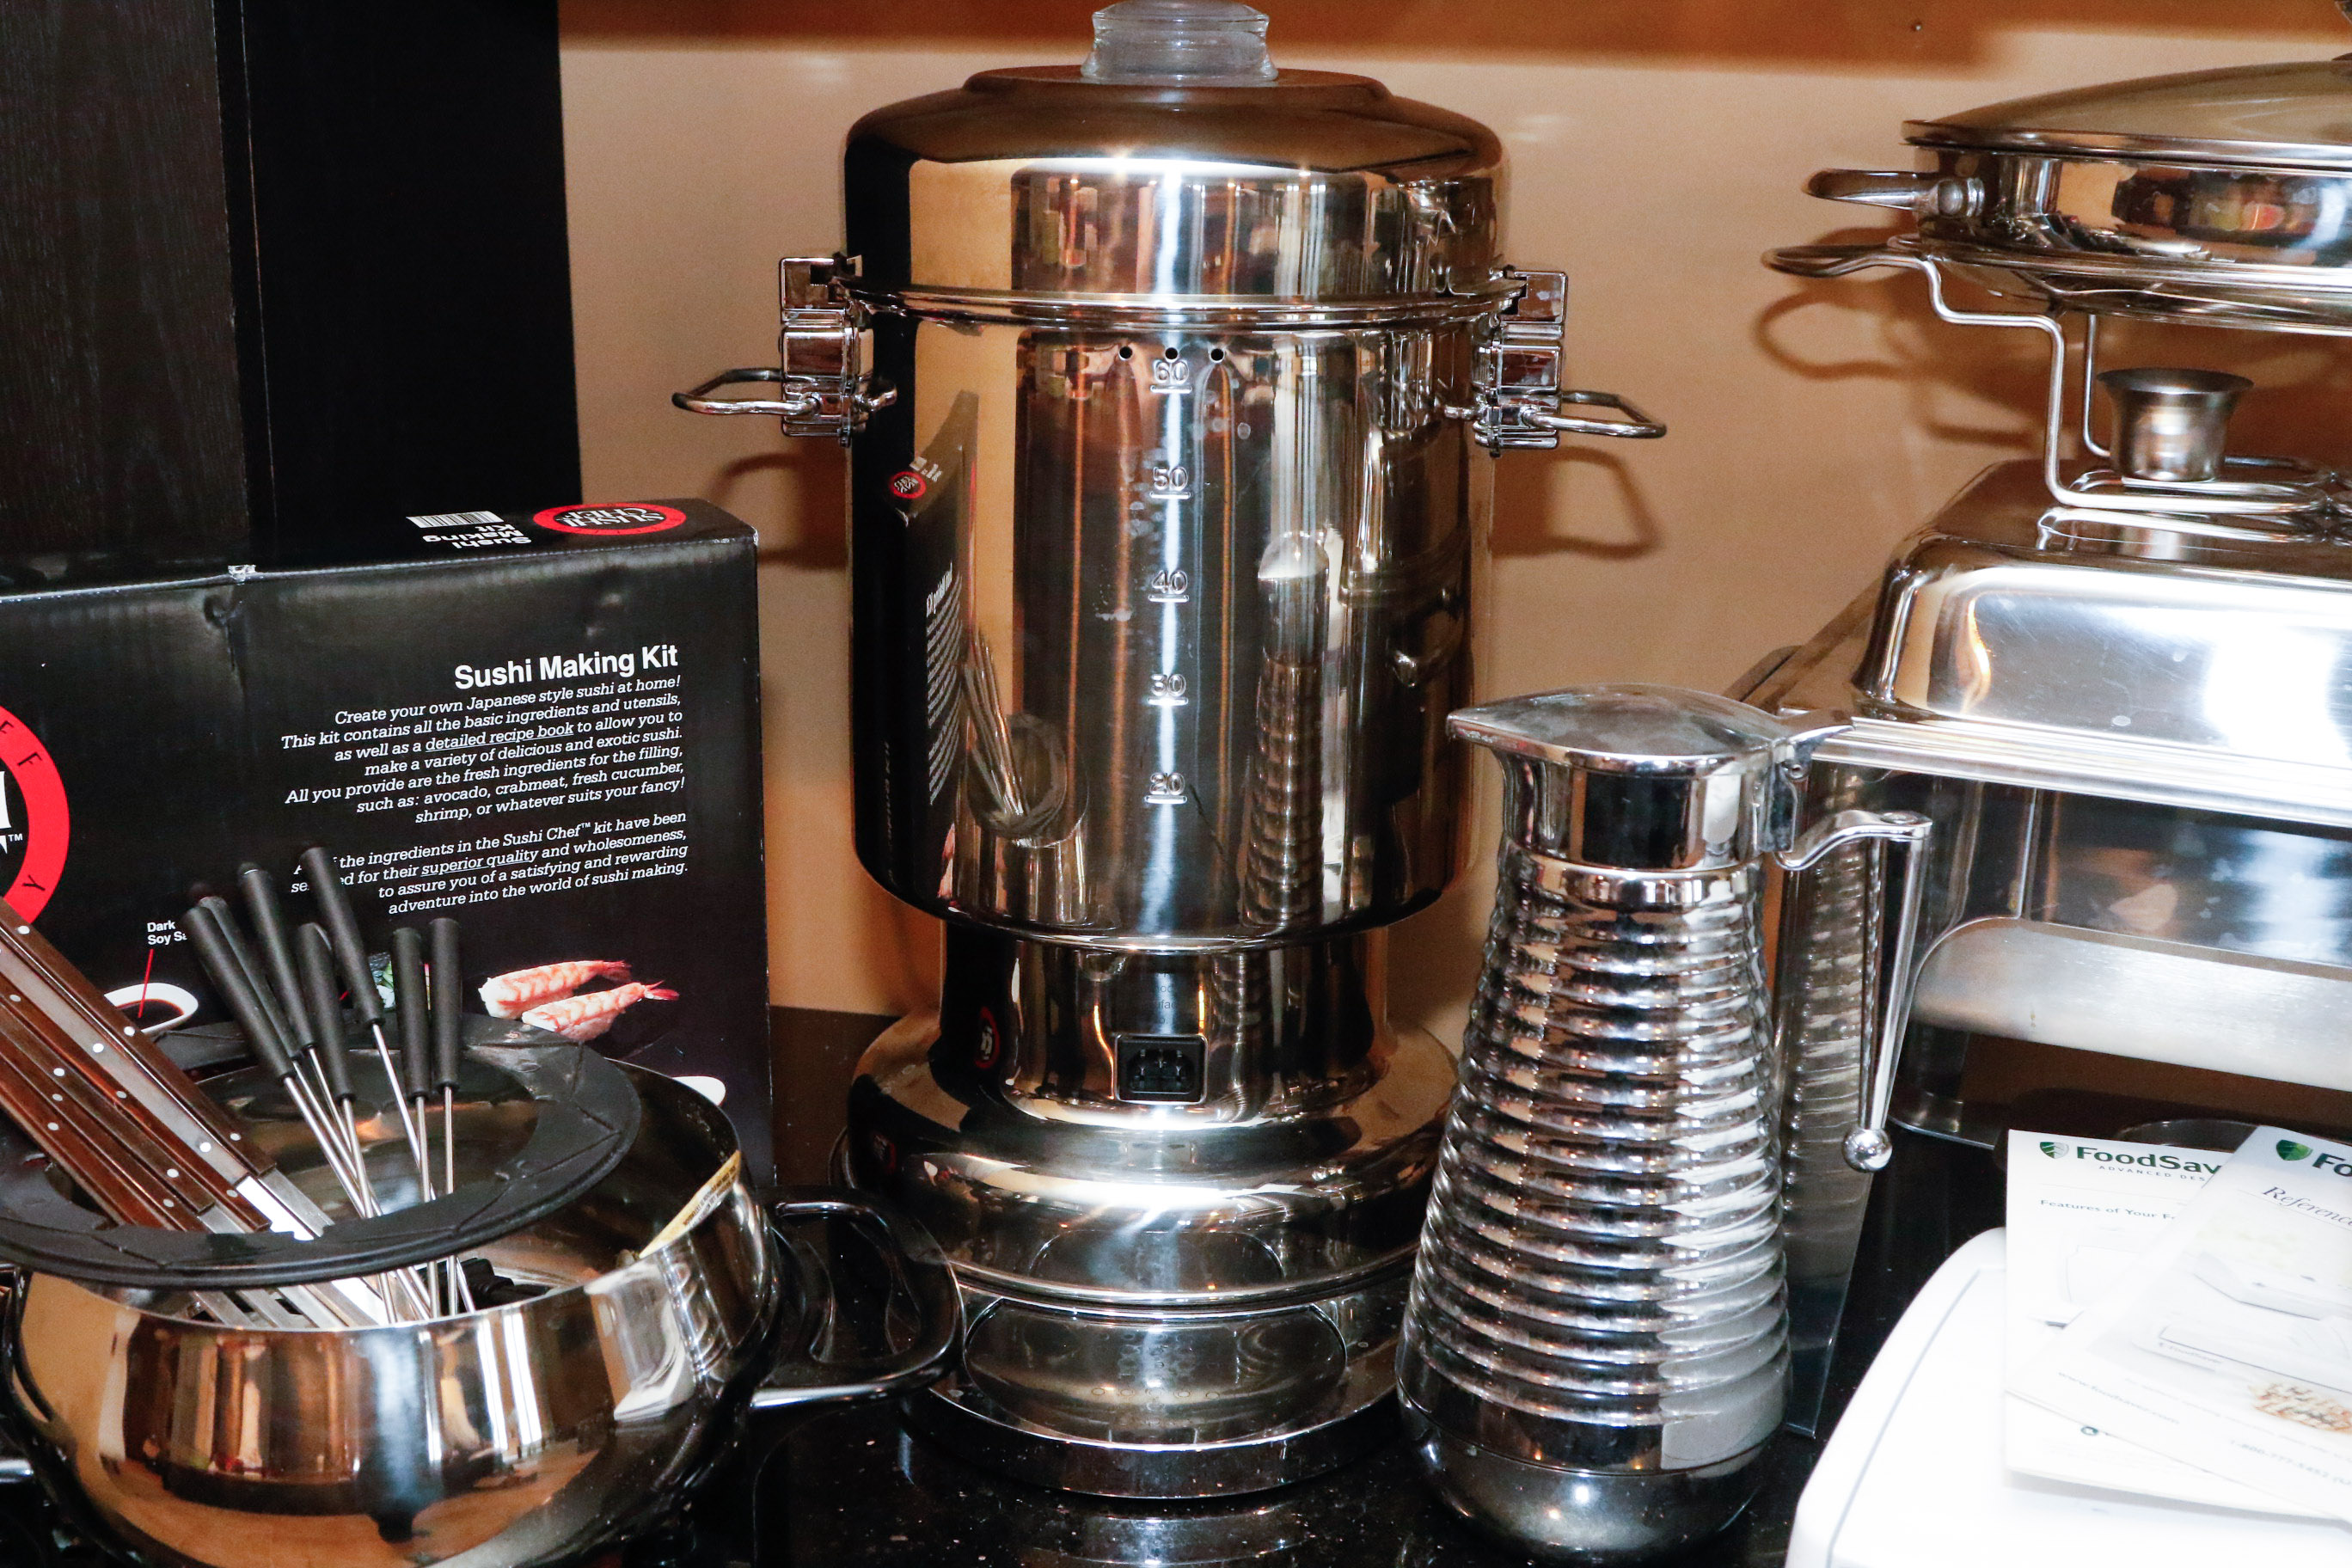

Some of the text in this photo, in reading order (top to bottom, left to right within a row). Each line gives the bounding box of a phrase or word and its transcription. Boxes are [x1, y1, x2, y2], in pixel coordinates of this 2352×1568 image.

[1154, 360, 1189, 384] 60
[1154, 467, 1188, 490] 50
[423, 530, 524, 542] Making
[563, 513, 665, 527] SUSHI
[452, 537, 532, 548] Sushi
[1152, 570, 1187, 593] 40
[455, 644, 678, 689] Sushi Making Kit
[335, 675, 681, 725] Create your own Japanese style sushi at home!
[1150, 673, 1186, 696] 30
[281, 693, 681, 749] This kit contains all the basic ingredients and utensils,
[334, 711, 683, 762] as well as a detailed recipe book to allow you to
[364, 726, 682, 775] make a variety of delicious and exotic sushi.
[285, 745, 683, 804] All you provide are the fresh ingredients for the filling,
[357, 763, 683, 812] such as: avocado, crabmeat, fresh cucumber,
[1149, 772, 1185, 795] 20
[415, 776, 685, 823] shrimp, or whatever suits your fancy!
[340, 855, 364, 868] the
[368, 844, 455, 865] ingredients
[456, 840, 472, 853] in
[475, 837, 499, 850] the
[503, 830, 542, 846] Sushi
[593, 821, 613, 834] kit
[616, 818, 650, 831] have
[652, 813, 686, 826] been
[358, 871, 380, 884] for
[383, 865, 420, 880] their
[420, 857, 484, 877] superior
[483, 849, 539, 868] quality
[542, 842, 570, 858] and
[573, 830, 686, 854] wholesomeness,
[378, 846, 689, 897] to assure you of a satisfying and rewarding
[389, 863, 688, 914] adventure into the world of sushi making.
[147, 920, 176, 933] Dark
[147, 934, 171, 945] Soy
[2099, 1165, 2172, 1177] ADVANCED
[2040, 1199, 2100, 1211] Features
[2125, 1209, 2157, 1217] Your
